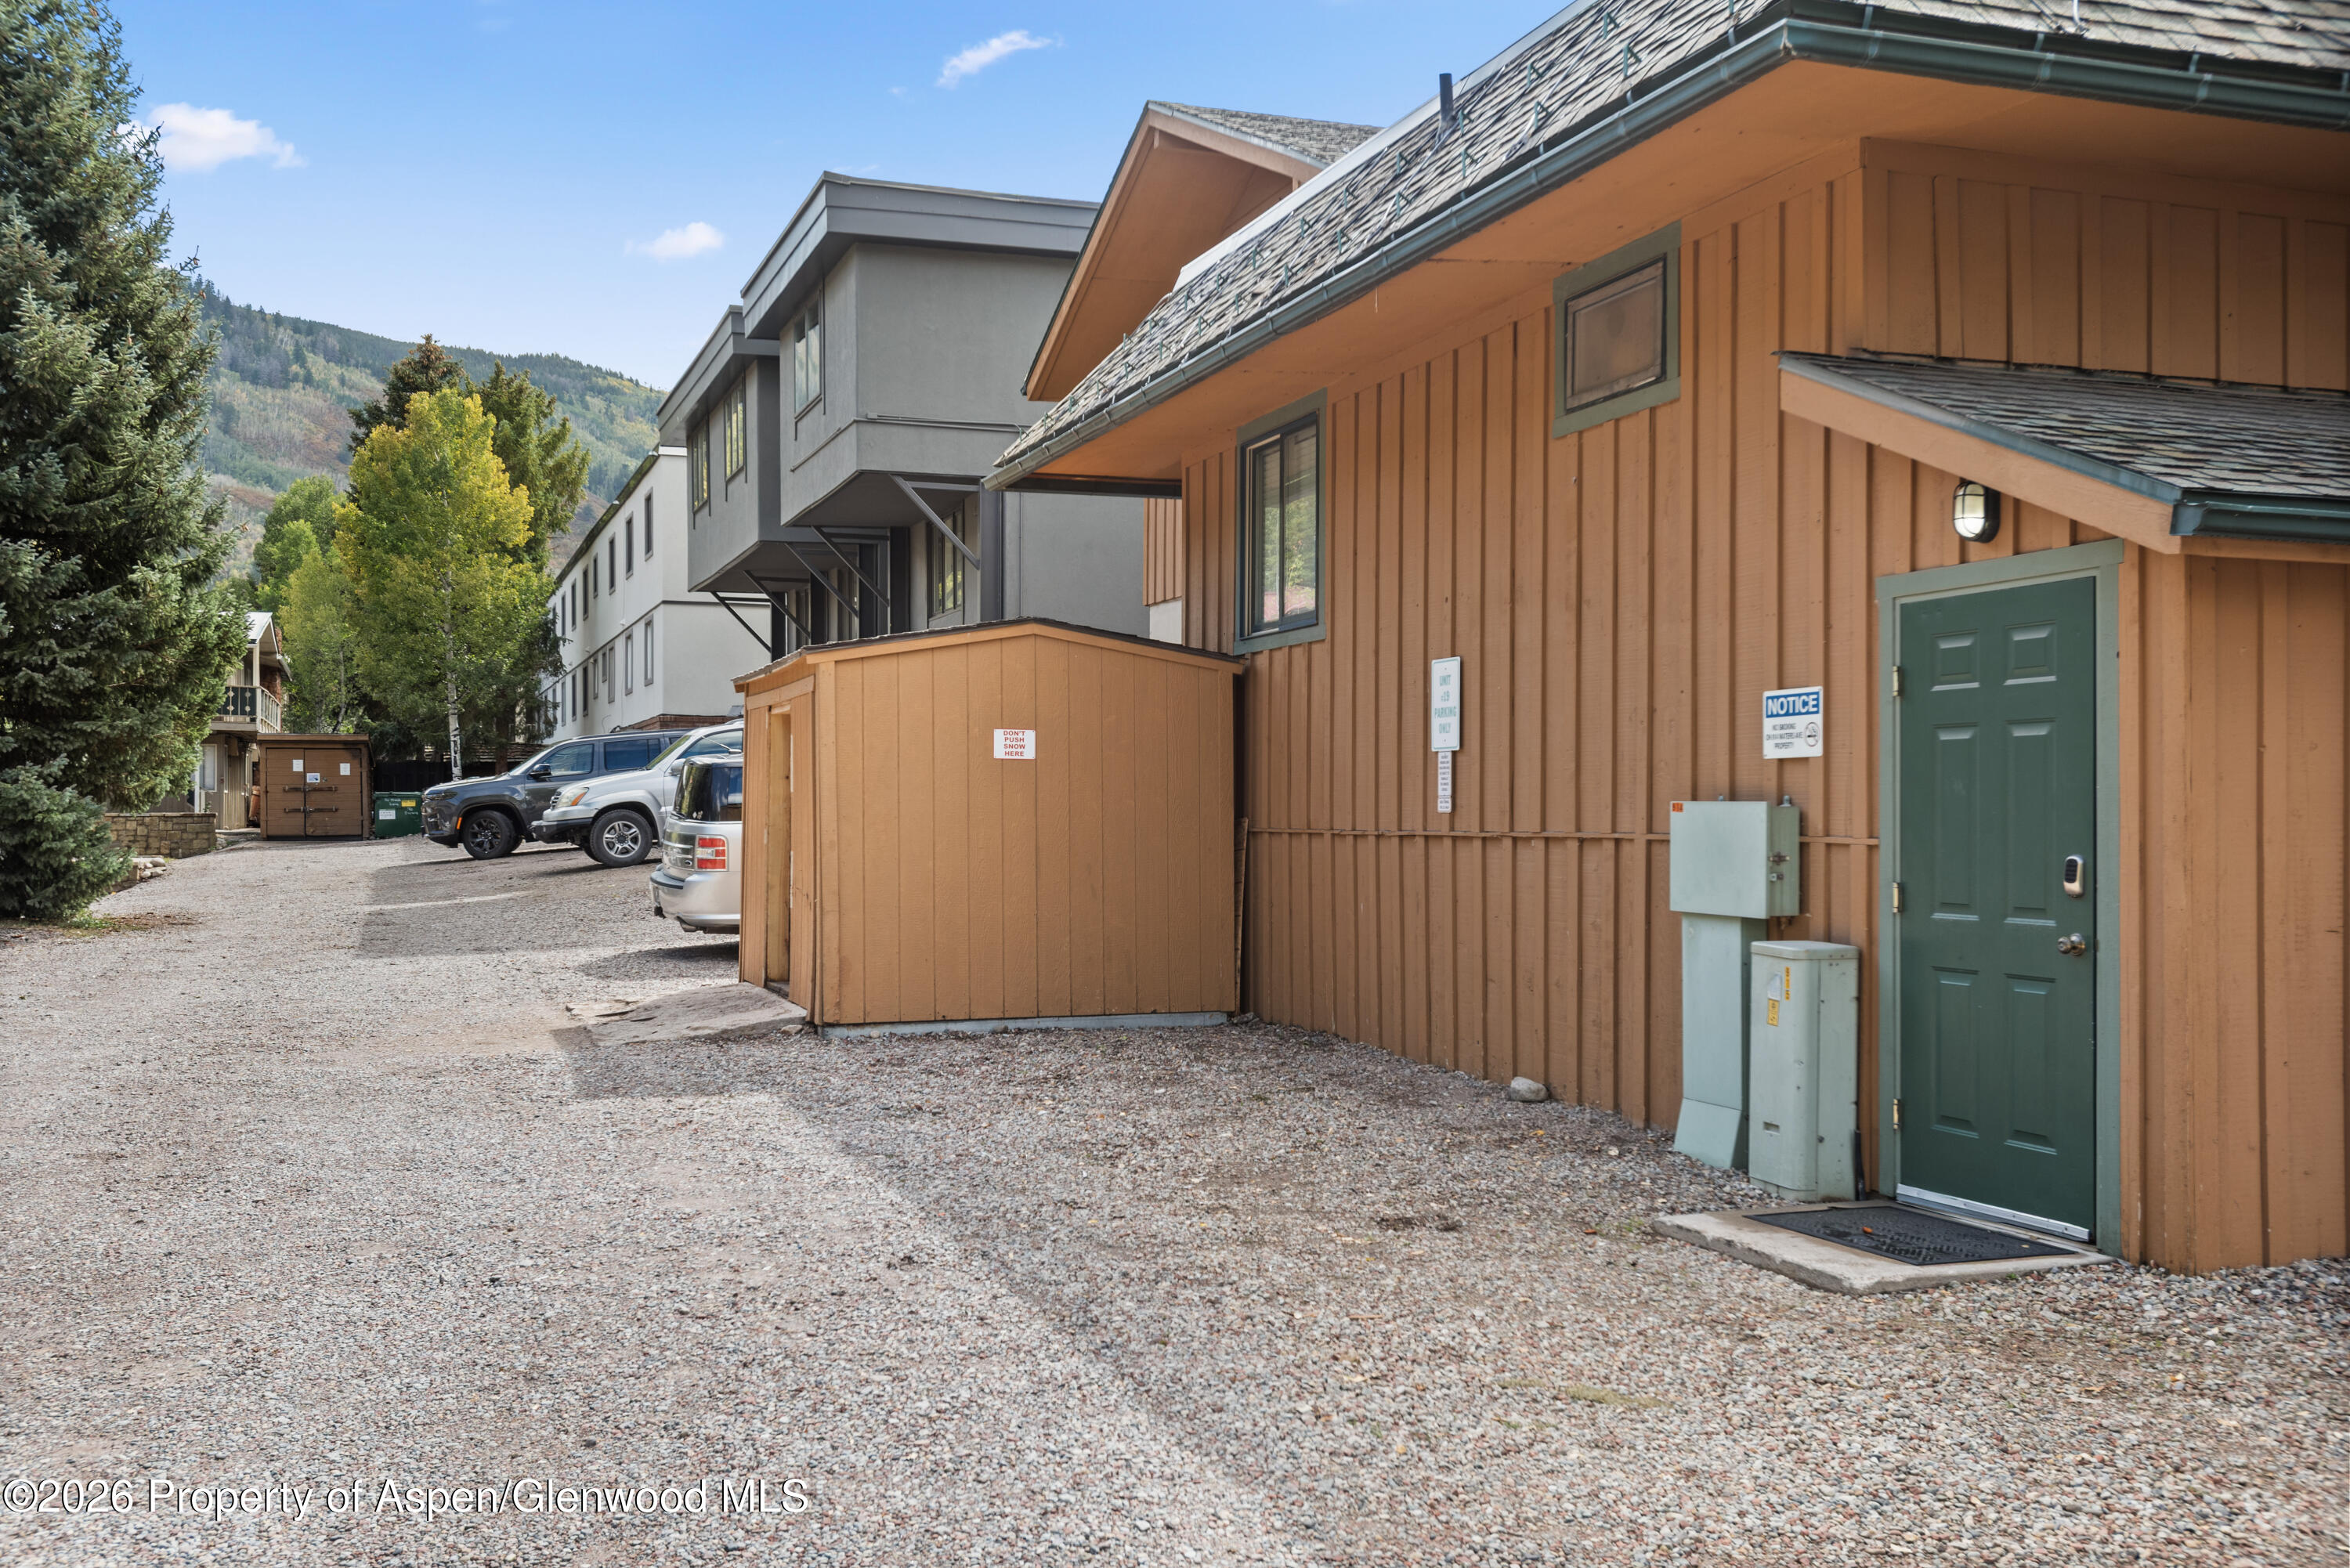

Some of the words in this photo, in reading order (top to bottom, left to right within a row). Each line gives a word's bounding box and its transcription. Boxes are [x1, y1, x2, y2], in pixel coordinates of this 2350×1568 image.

[1439, 674, 1451, 686] UNIT
[1766, 695, 1818, 715] NOTICE
[1434, 706, 1456, 718] PARKING
[1439, 722, 1451, 734] ONLY
